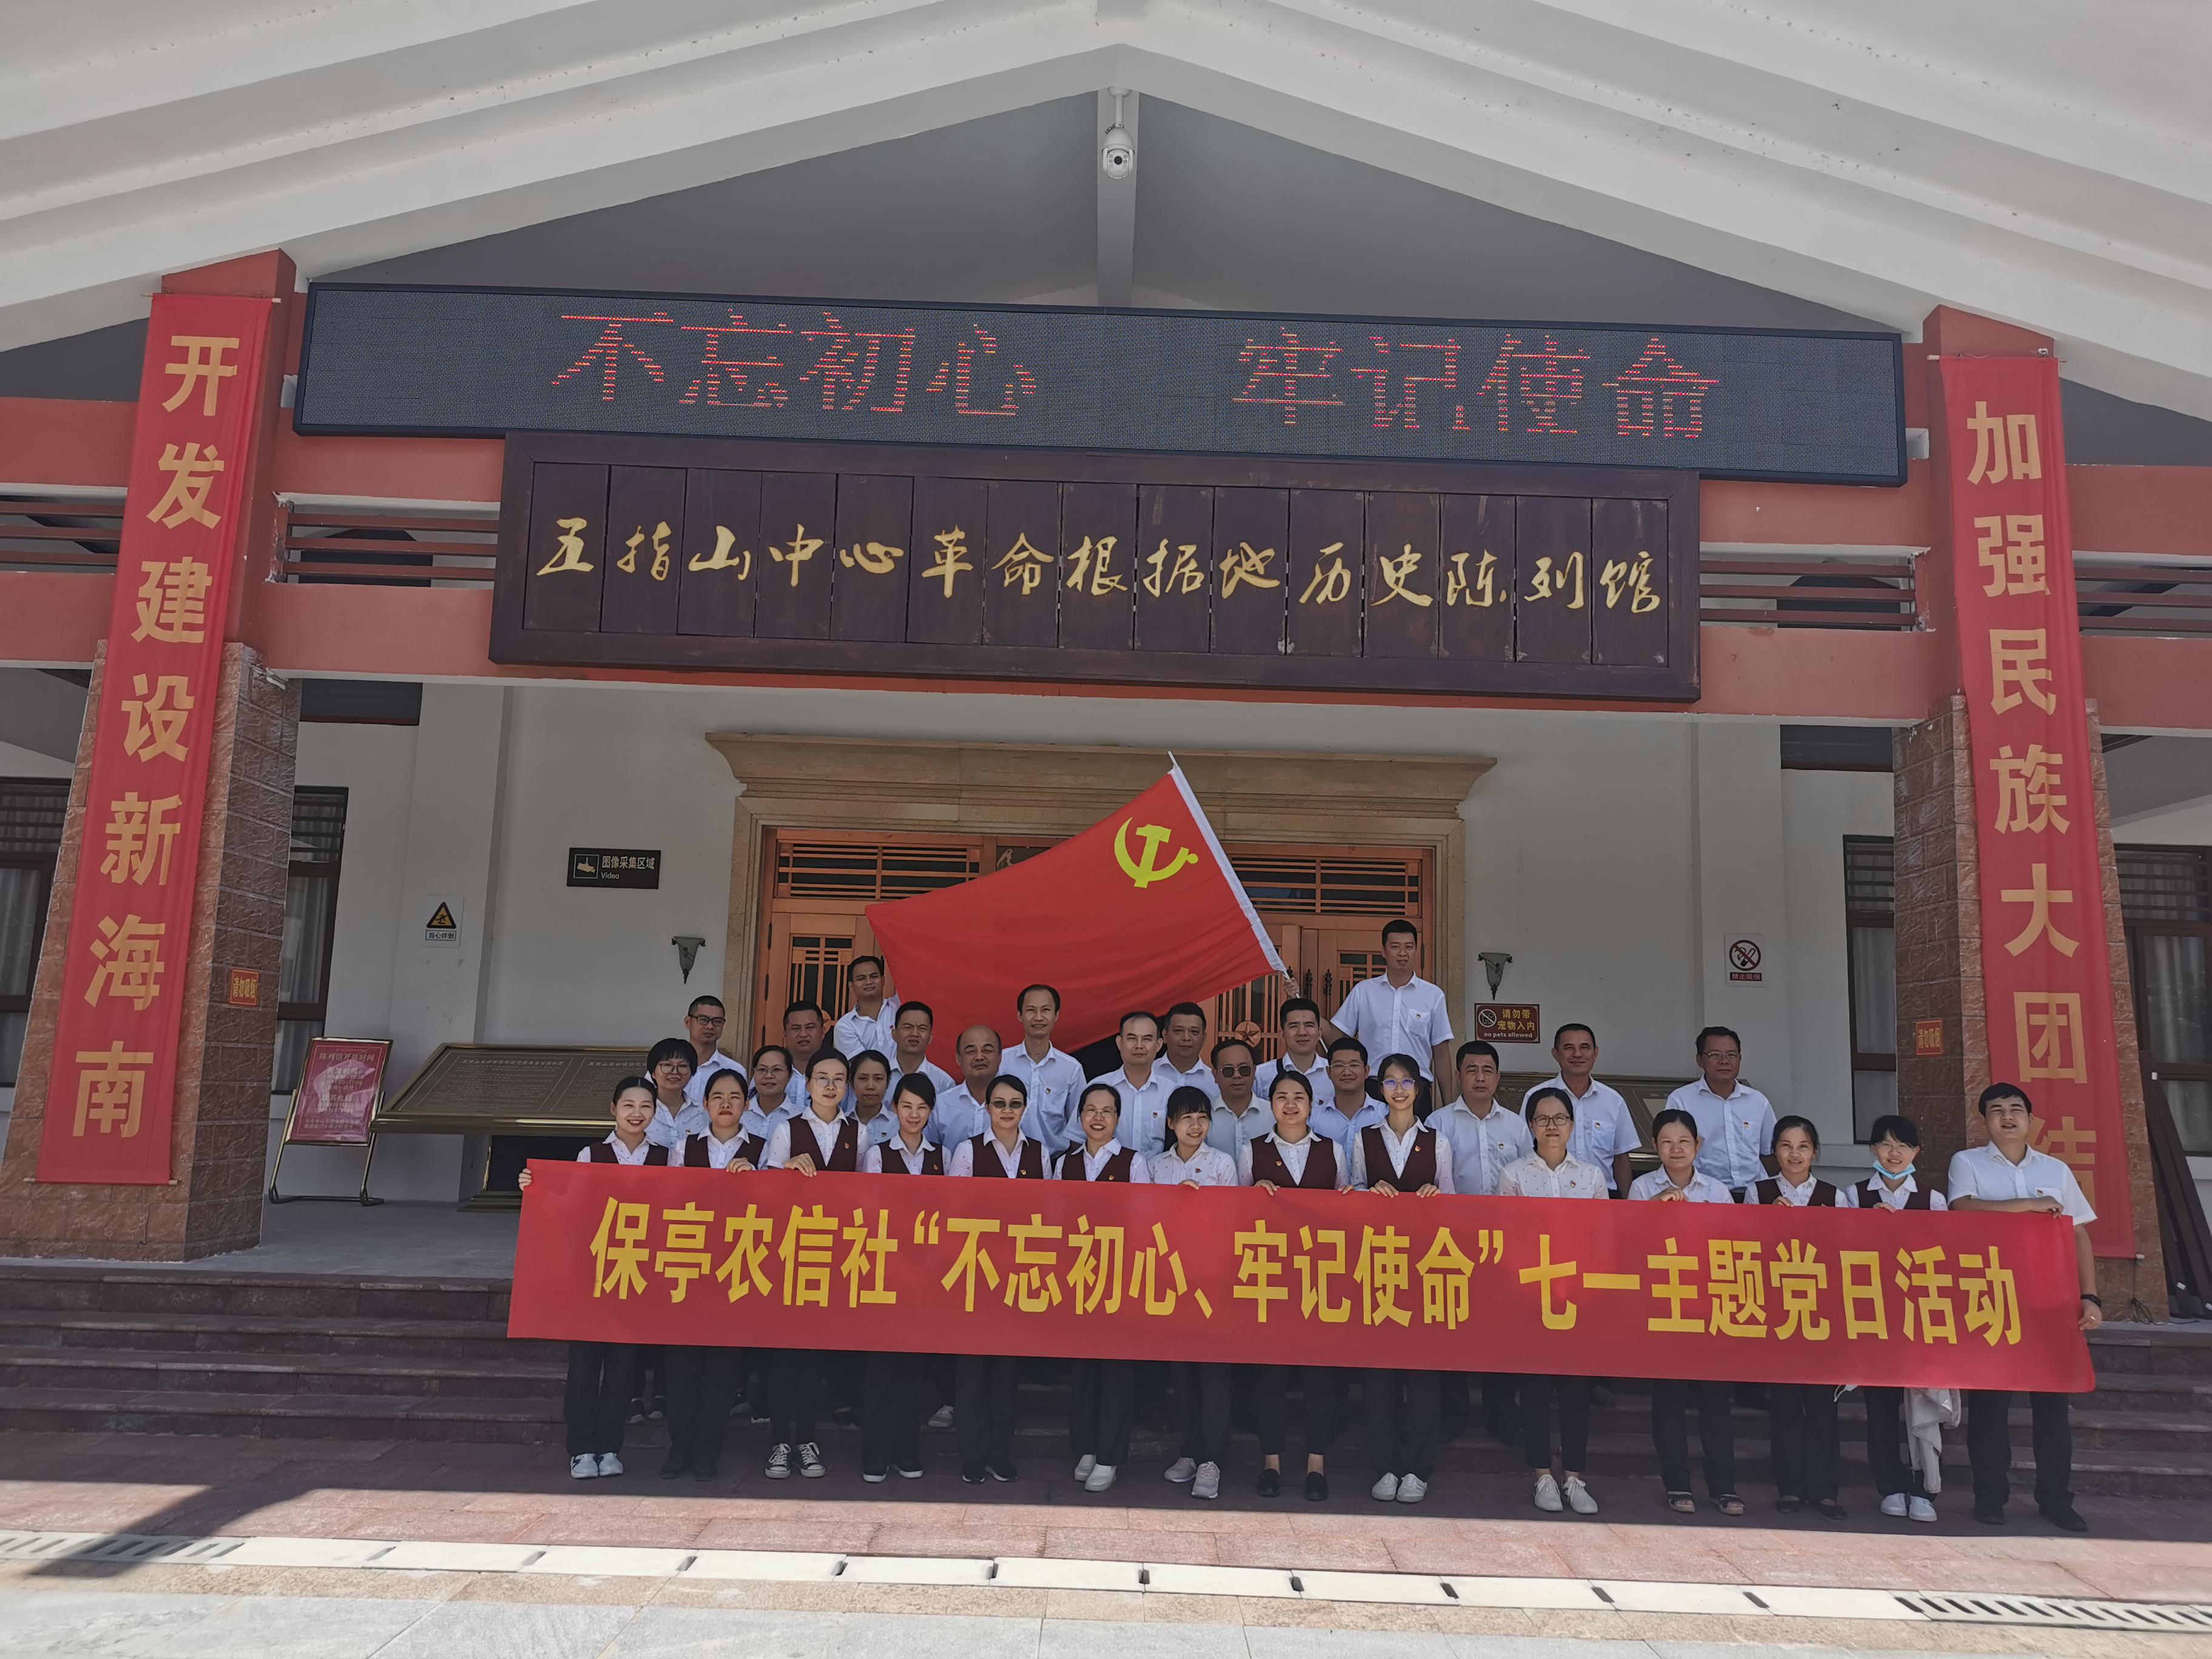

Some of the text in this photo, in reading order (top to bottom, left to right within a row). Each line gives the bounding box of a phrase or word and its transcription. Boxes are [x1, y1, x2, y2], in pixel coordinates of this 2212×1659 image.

[551, 308, 1720, 439] 不忘初心 牢记使命
[536, 517, 1661, 614] 五指山中心革命根据地历史陈列馆
[72, 335, 240, 1138] 开发建设新海南
[602, 856, 655, 870] 图像采集区域
[1497, 1021, 1535, 1030] 宠物入内
[1502, 1008, 1530, 1019] 请勿带
